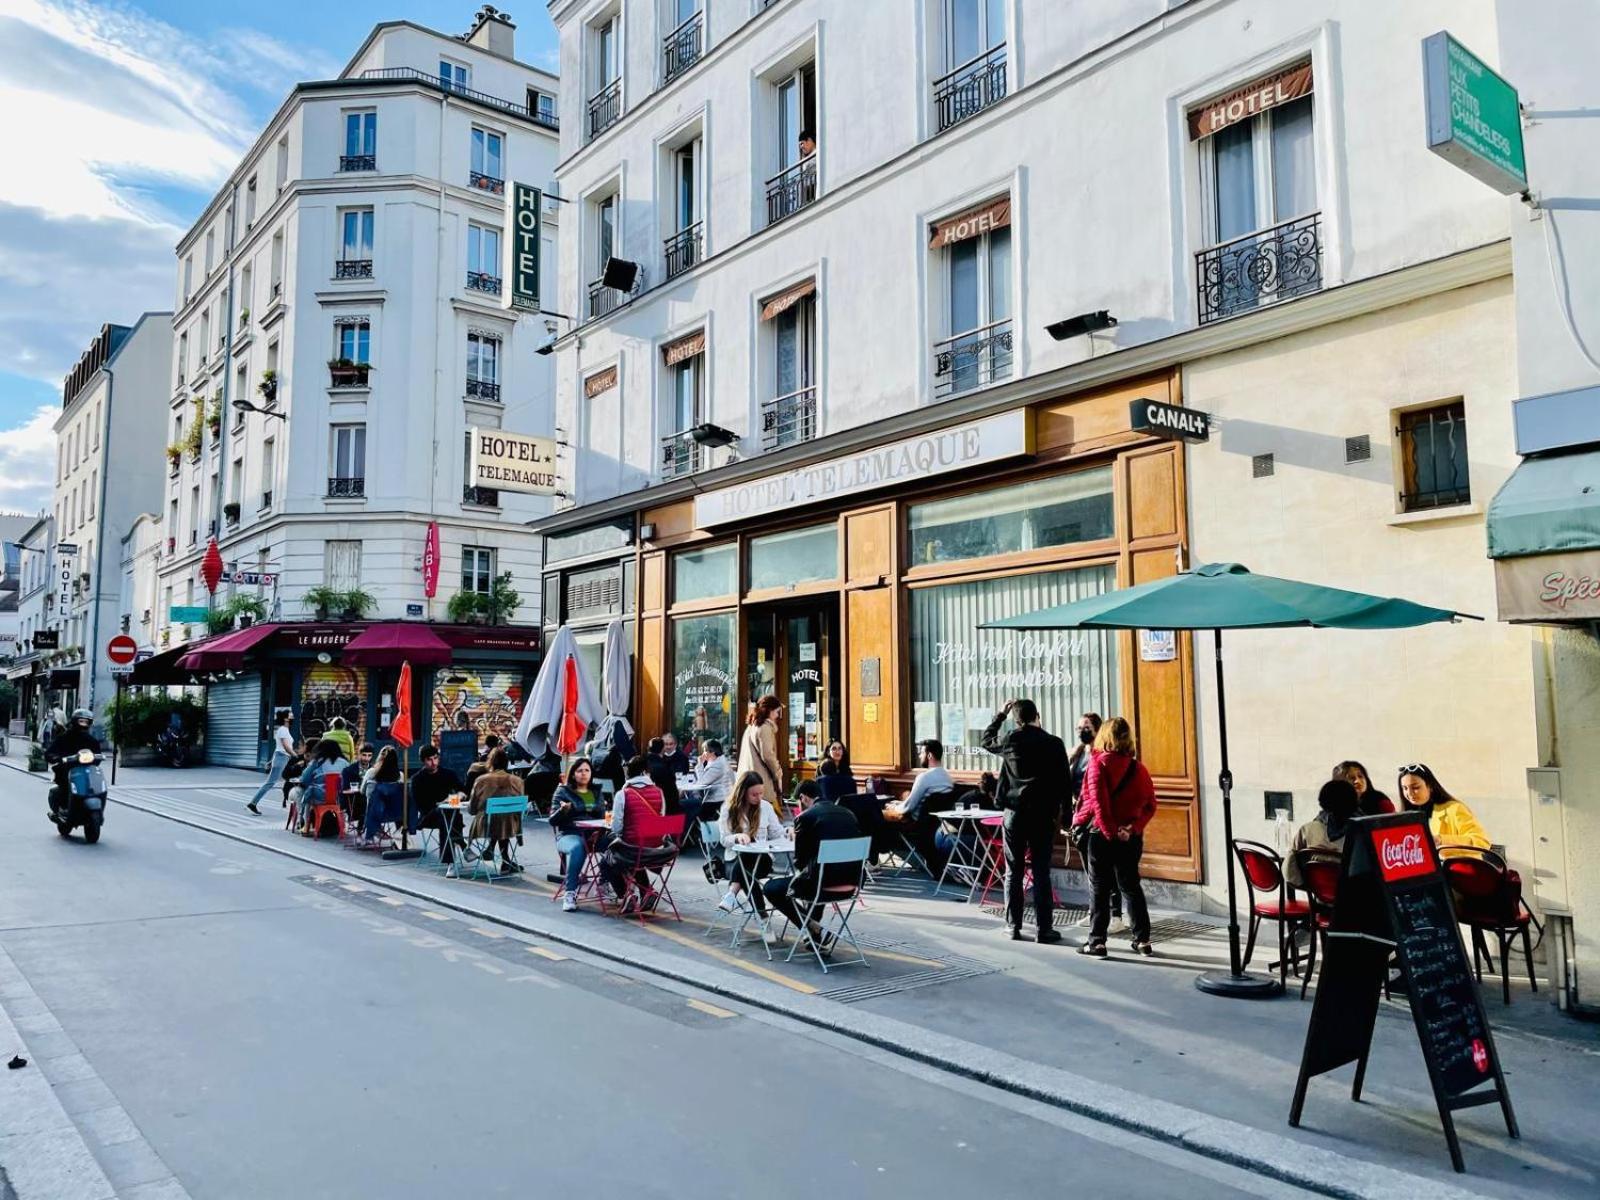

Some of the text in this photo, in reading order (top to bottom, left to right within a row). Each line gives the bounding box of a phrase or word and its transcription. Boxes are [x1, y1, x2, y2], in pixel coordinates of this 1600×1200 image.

[1210, 82, 1289, 130] HOTEL
[518, 188, 536, 295] HOTEL
[944, 211, 999, 244] HOTEL
[670, 340, 700, 361] HOTEL
[592, 377, 614, 392] HOTEL
[1147, 404, 1205, 434] CANAL+
[480, 436, 540, 462] HOTEL
[478, 464, 555, 487] TELEMAQUE
[722, 426, 981, 518] HOTEL TELEMAQUE
[60, 559, 71, 616] HOTEL
[299, 636, 308, 645] LE
[791, 669, 821, 684] HOTEL
[1382, 834, 1425, 870] Coca-Cola
